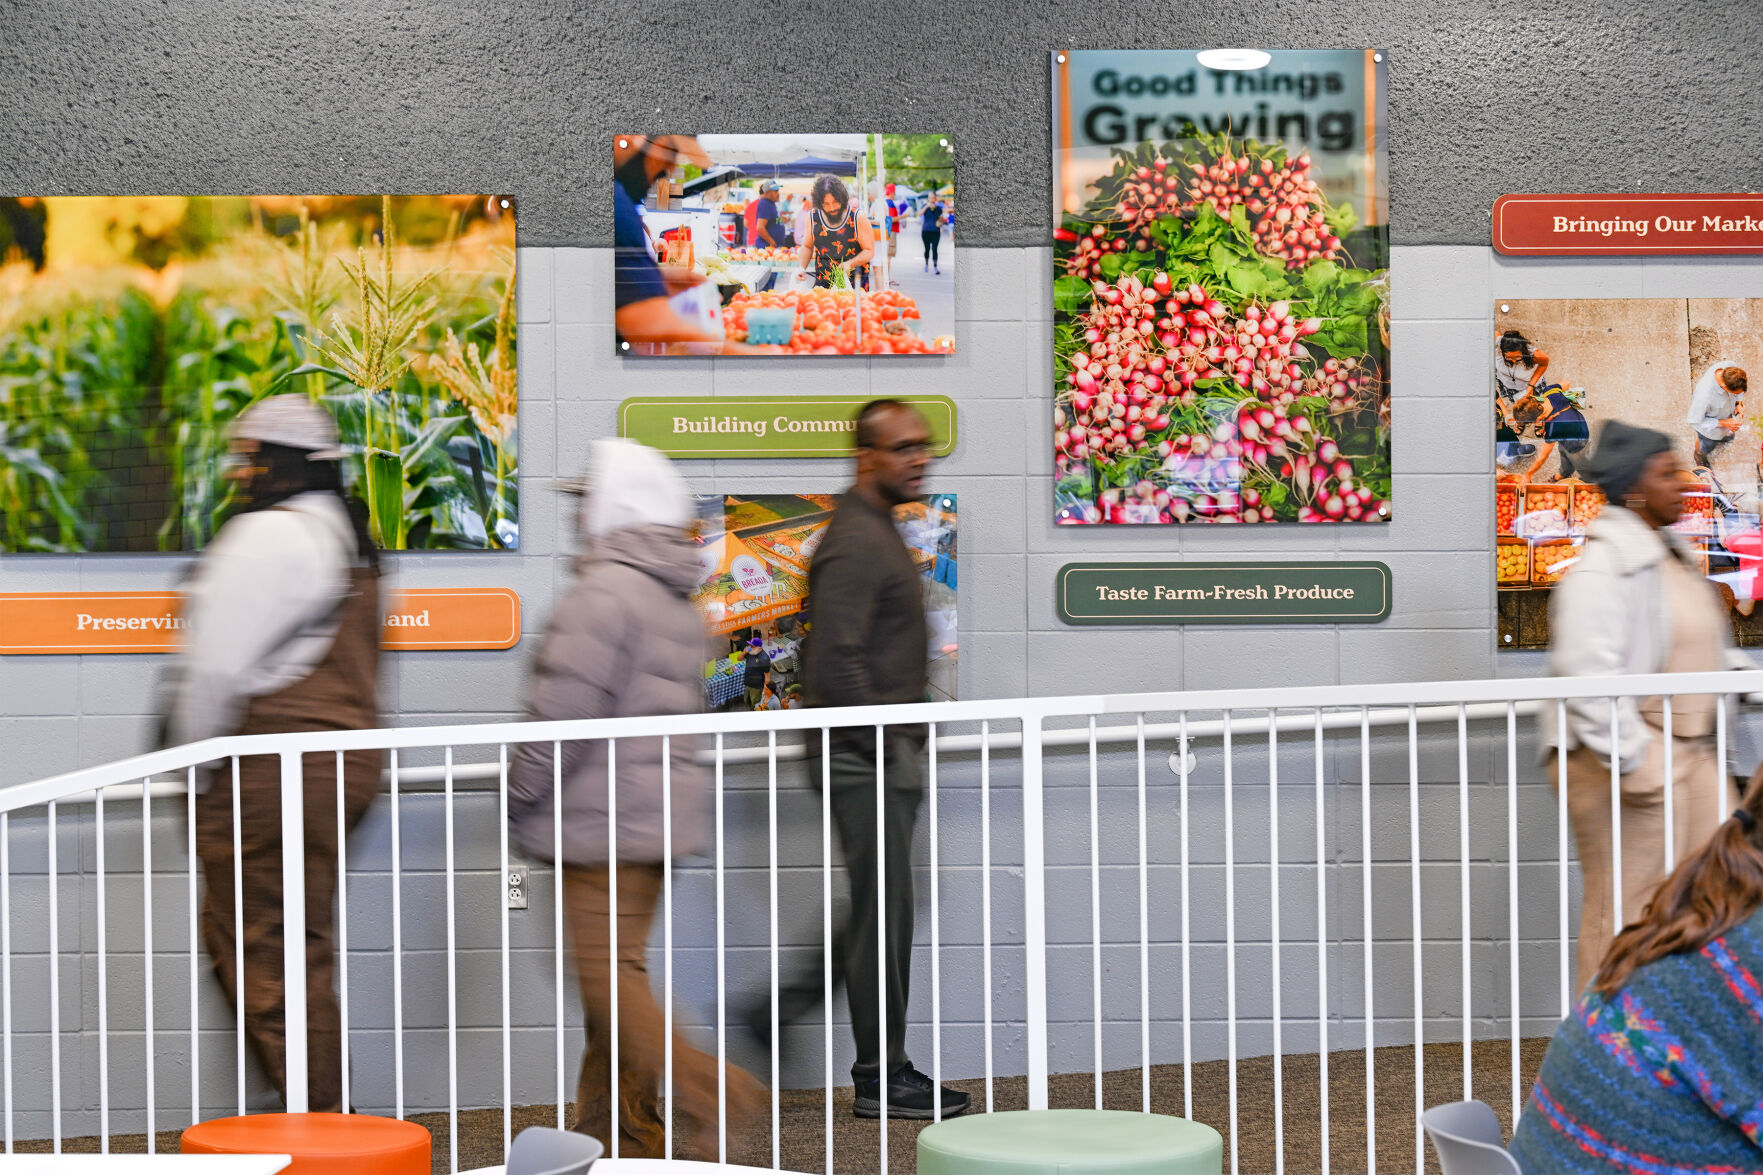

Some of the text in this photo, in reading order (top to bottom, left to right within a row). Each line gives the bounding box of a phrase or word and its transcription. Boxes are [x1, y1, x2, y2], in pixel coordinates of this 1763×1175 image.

[1092, 69, 1345, 99] Good Things
[1084, 104, 1356, 151] Growing
[1553, 216, 1650, 237] Bringing
[1655, 216, 1697, 232] Our
[673, 416, 858, 437] Building Commu
[1096, 585, 1355, 600] Taste Farm-Fresh Produce
[737, 609, 770, 626] FARMERS
